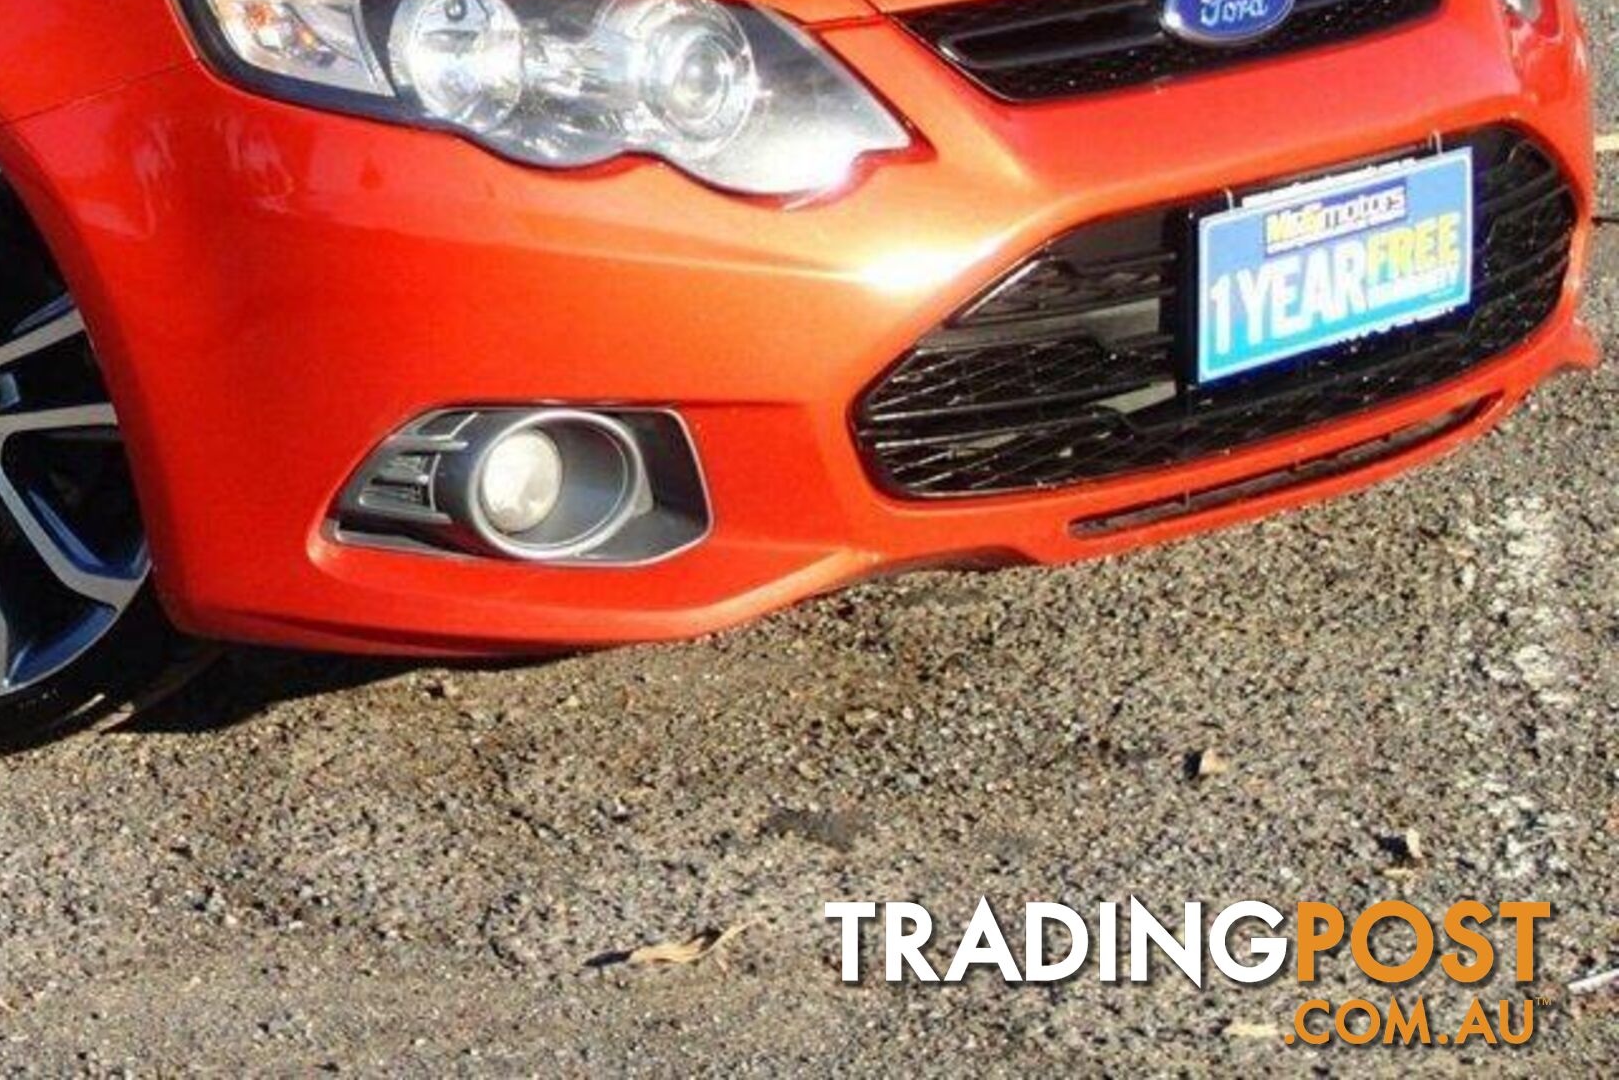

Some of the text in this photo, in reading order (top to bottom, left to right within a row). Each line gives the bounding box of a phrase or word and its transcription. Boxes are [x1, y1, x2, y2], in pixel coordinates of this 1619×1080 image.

[1208, 275, 1232, 355] 1
[1235, 242, 1369, 346] YEAR
[1366, 212, 1460, 286] FREE
